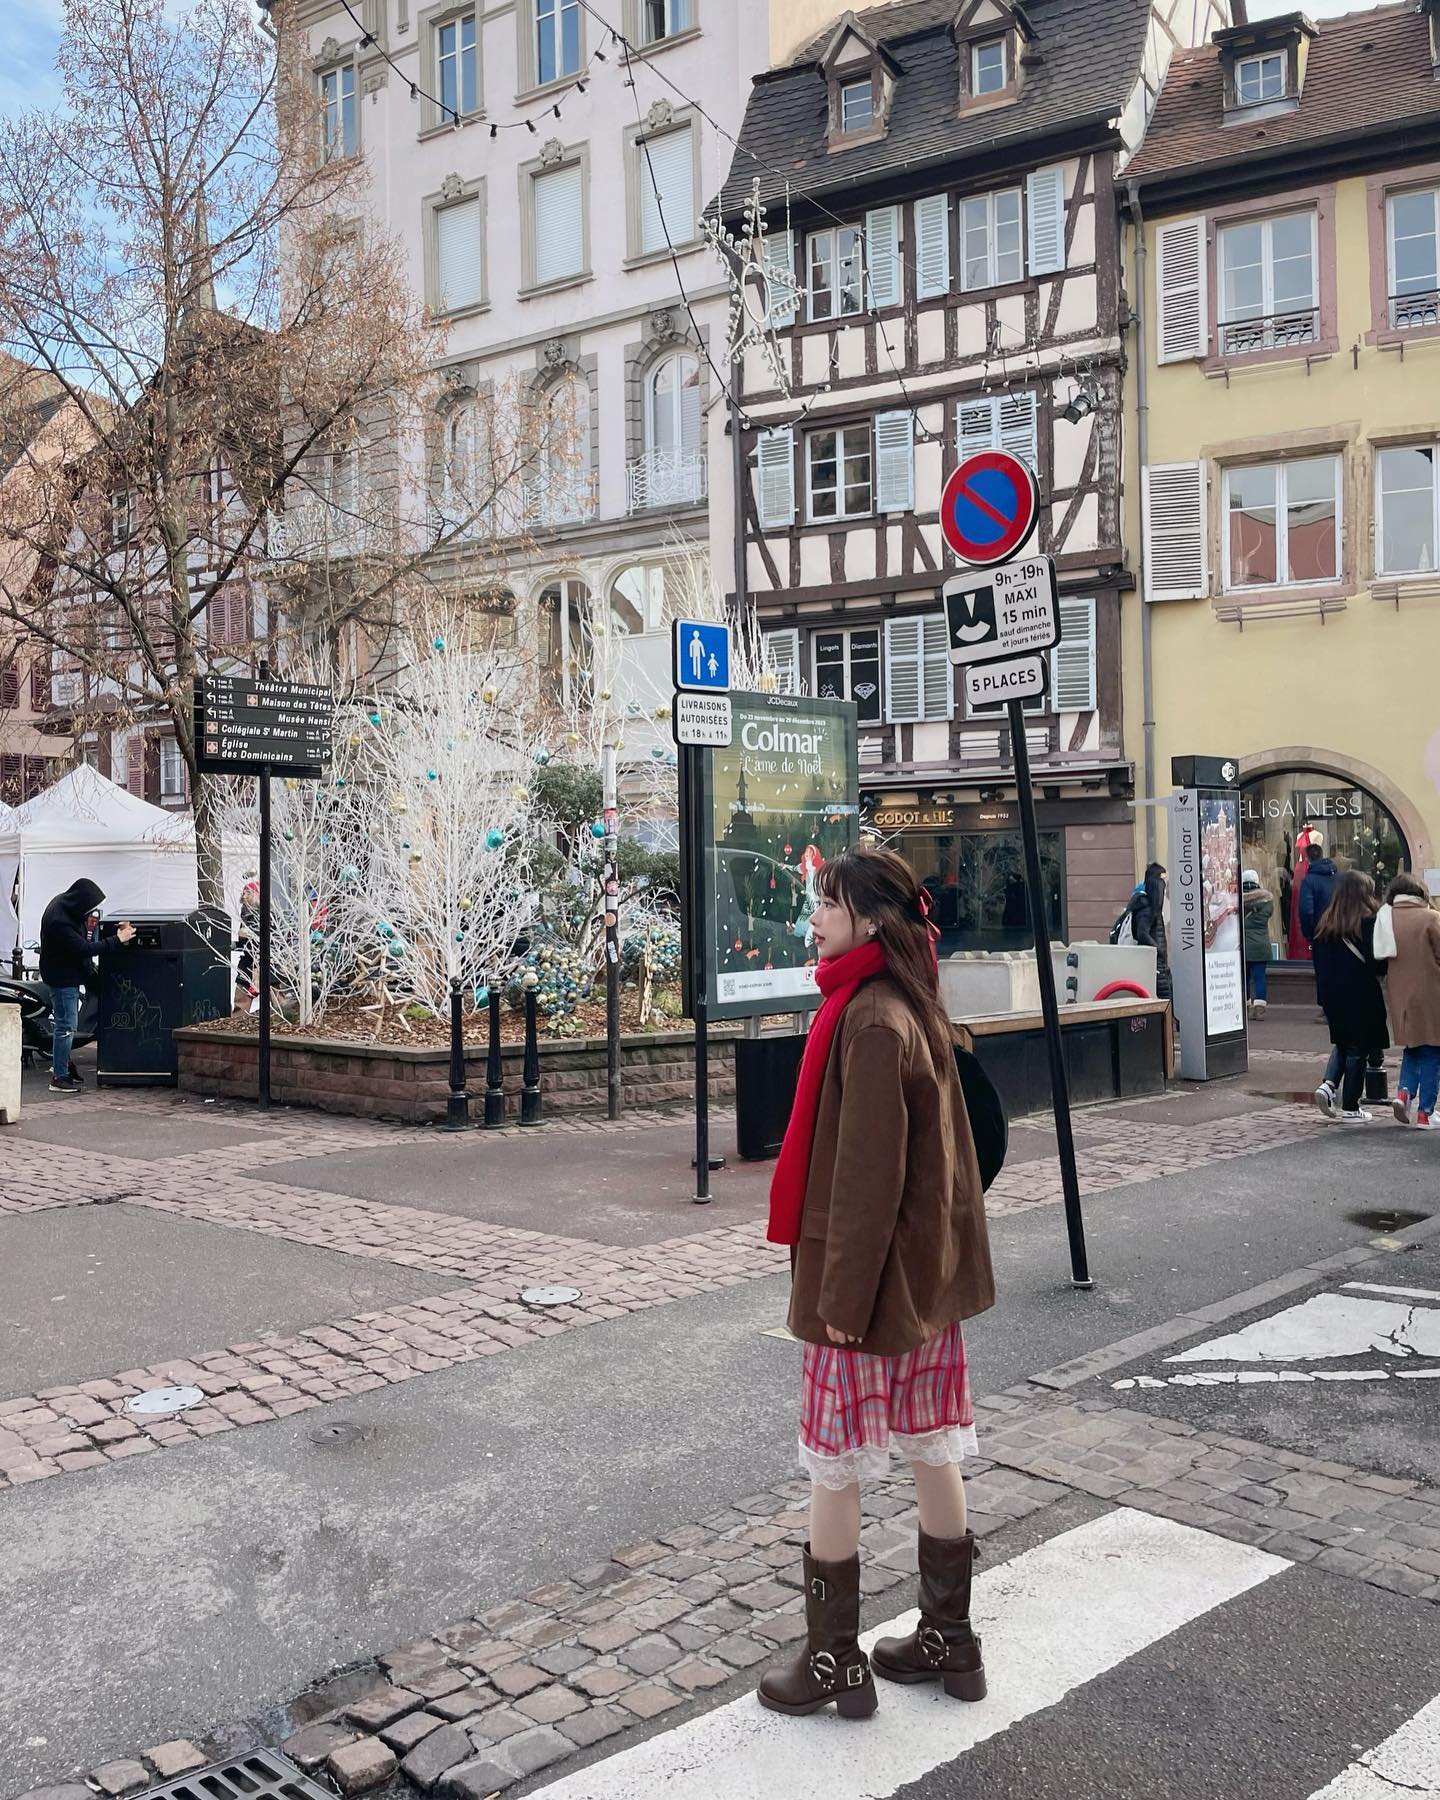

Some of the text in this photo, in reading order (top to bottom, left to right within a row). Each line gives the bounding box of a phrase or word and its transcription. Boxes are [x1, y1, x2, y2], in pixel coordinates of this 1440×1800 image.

[1005, 586, 1037, 605] MAXI
[1002, 605, 1047, 625] 15 min
[1000, 621, 1051, 637] sauf dimanche
[851, 642, 878, 650] Diamants
[1002, 632, 1051, 648] et jours fériés
[972, 669, 1037, 692] 5 PLACES
[254, 681, 332, 698] Théâtre Municipal
[261, 697, 332, 711] Maison des Têtes
[681, 699, 727, 711] LIVRAISONS
[766, 696, 799, 708] JCDecaux
[278, 713, 331, 726] Musée Hansi
[680, 714, 728, 726] AUTORISÉES
[221, 724, 261, 737] Collégiale
[272, 727, 298, 738] Martin
[741, 722, 823, 754] Colmar
[221, 737, 249, 750] Église
[221, 749, 294, 761] des Dominicains
[781, 757, 795, 773] de
[797, 754, 824, 777] Noël
[1174, 805, 1194, 813] Colmar
[1306, 796, 1361, 817] NESS
[873, 811, 920, 826] GODOT
[922, 813, 930, 823] &
[1178, 827, 1195, 951] Ville de Colmar
